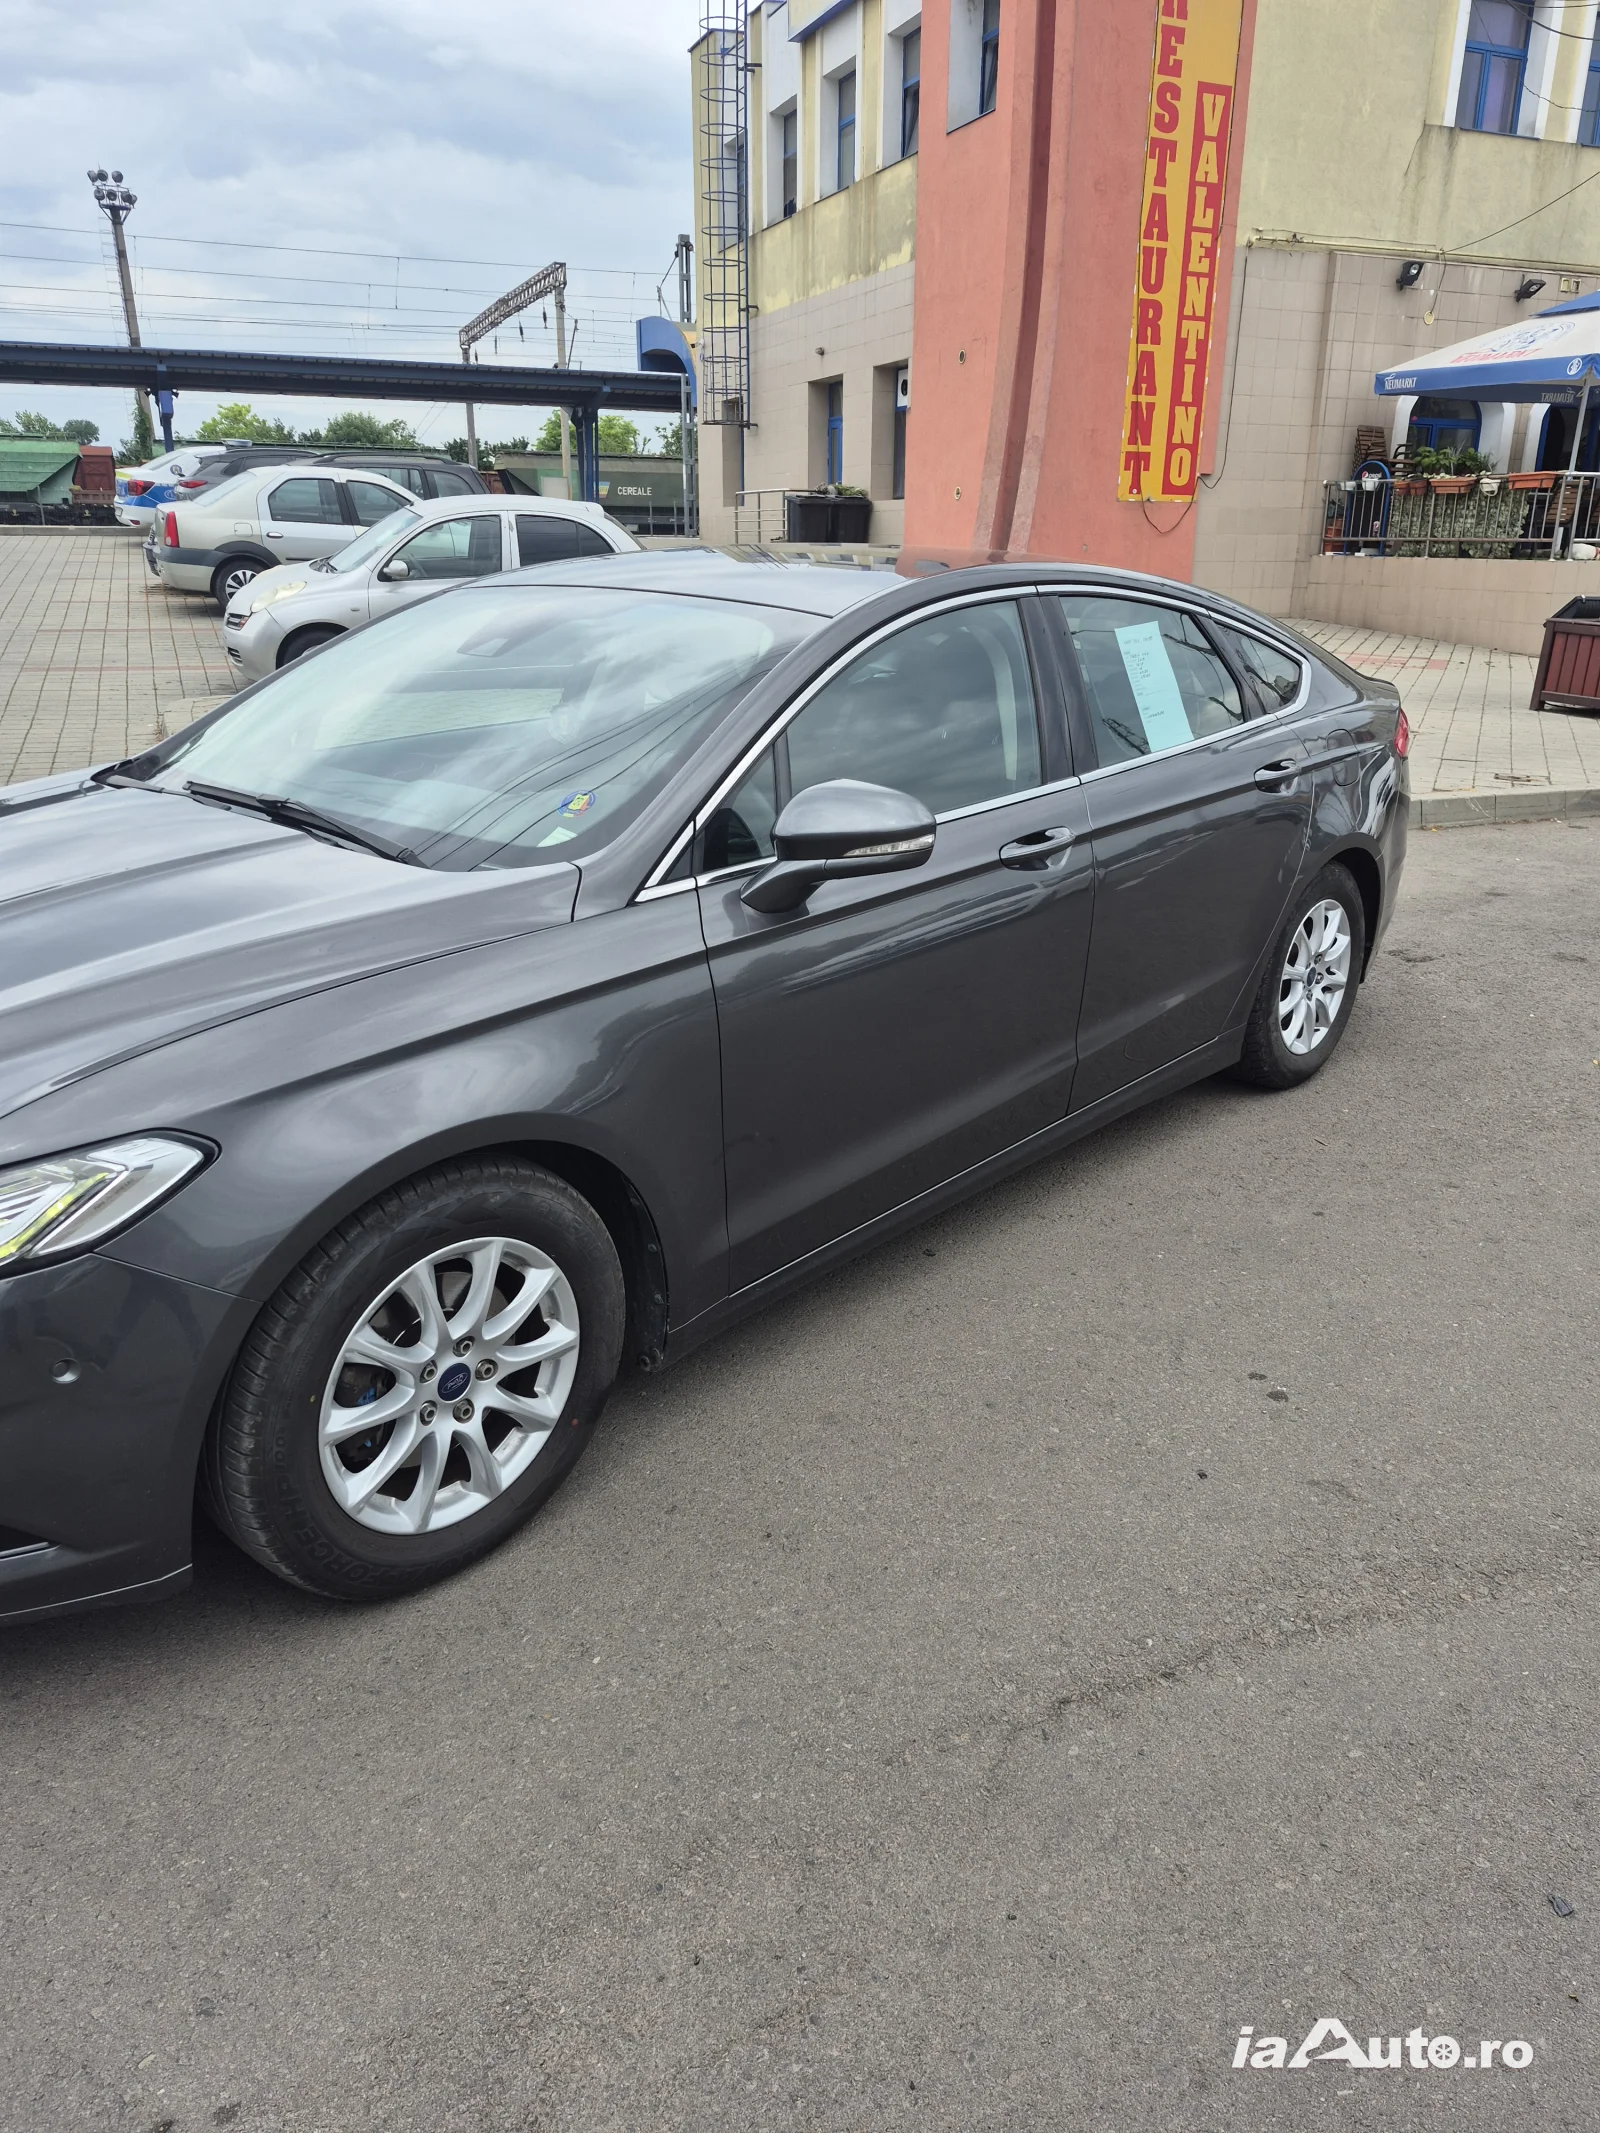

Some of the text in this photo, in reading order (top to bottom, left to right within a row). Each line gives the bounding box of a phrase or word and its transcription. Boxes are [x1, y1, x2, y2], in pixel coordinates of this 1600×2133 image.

[1169, 93, 1226, 486] VALENTINO
[1384, 376, 1417, 390] NEUMARKT
[617, 486, 652, 496] CEREALE
